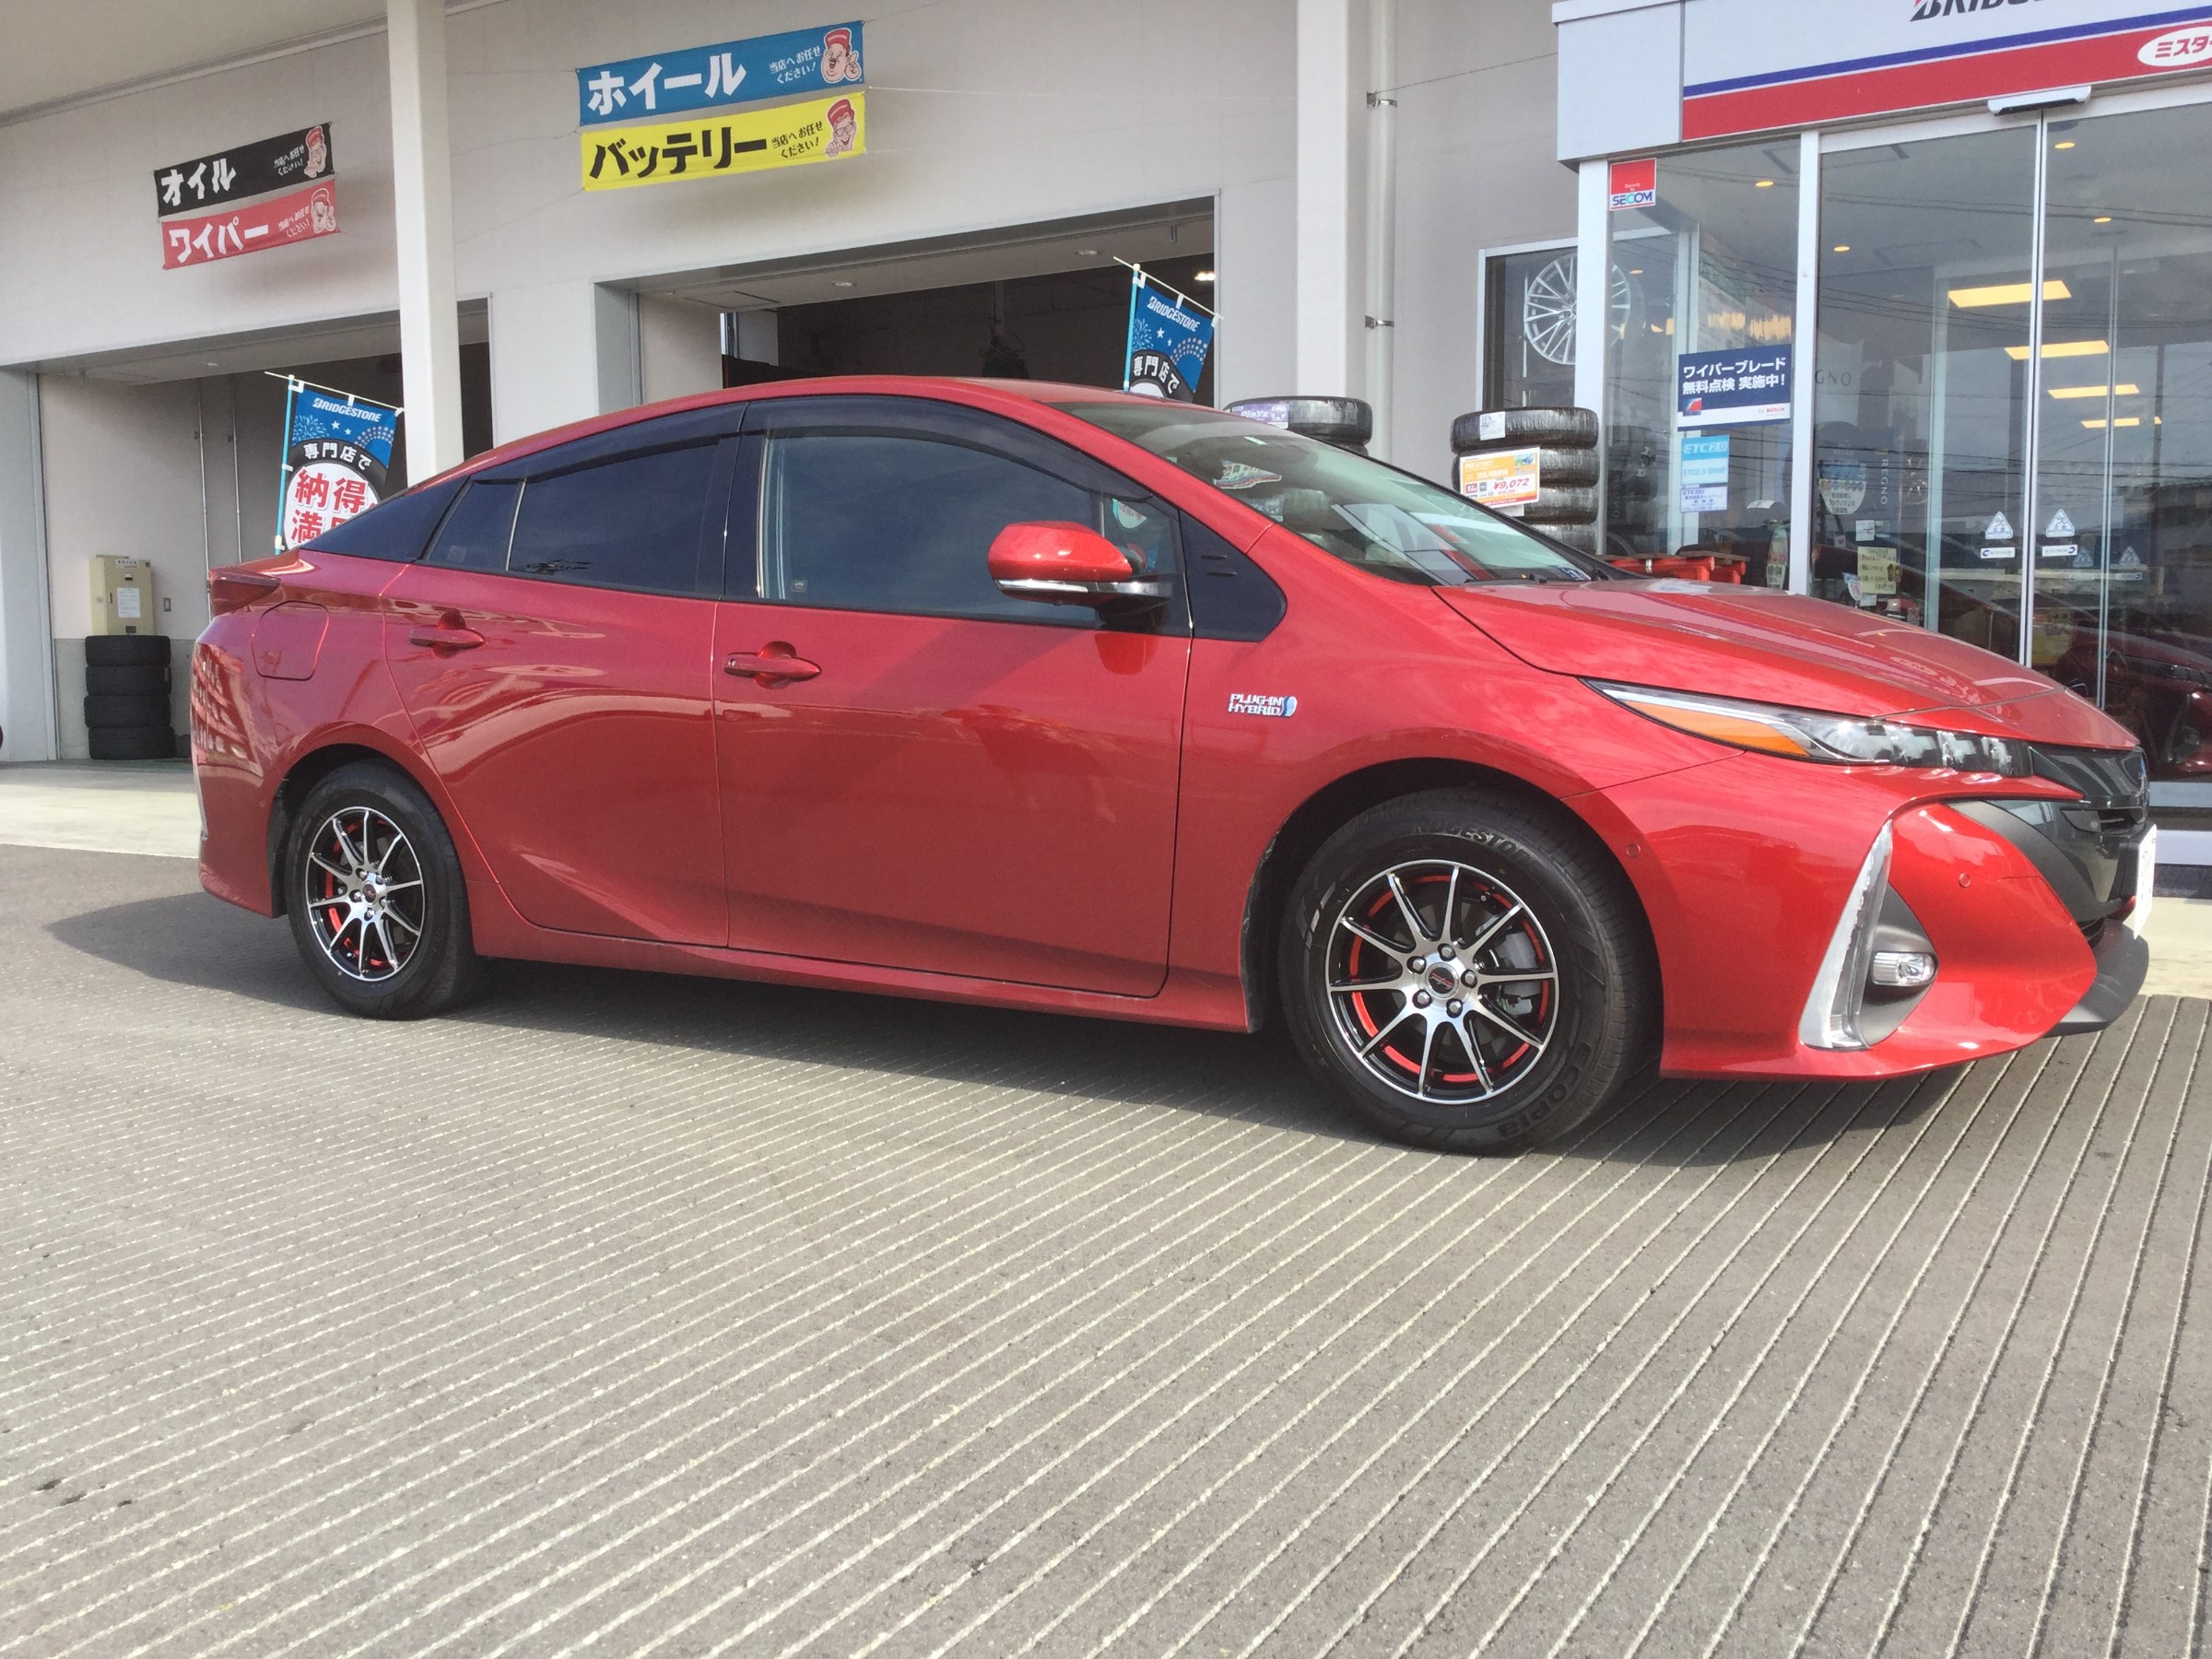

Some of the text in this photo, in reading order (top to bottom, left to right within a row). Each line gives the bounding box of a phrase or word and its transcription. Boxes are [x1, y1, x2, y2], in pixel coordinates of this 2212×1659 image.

[769, 45, 822, 75] 当店へお任せ
[2155, 35, 2212, 58] ミスタ
[587, 53, 747, 116] ホイール
[771, 120, 824, 150] 当店へお任せ
[589, 126, 768, 180] バッテリー
[160, 158, 238, 207] オイル
[1613, 191, 1653, 206] SECOM
[169, 216, 270, 265] ワイパー
[1147, 296, 1200, 332] BRIDGESTONE
[1133, 355, 1180, 394] 専門店で
[1683, 357, 1786, 379] ワイパーブレード
[1814, 369, 1853, 386] GNO
[1682, 378, 1735, 395] 無料点検
[312, 397, 382, 423] BRIDGESTONE
[303, 441, 371, 471] 専門店で
[294, 468, 377, 514] 納得
[1493, 477, 1530, 489] ¥9,072
[1880, 459, 1889, 505] REGNO
[1228, 702, 1282, 716] HYBRID
